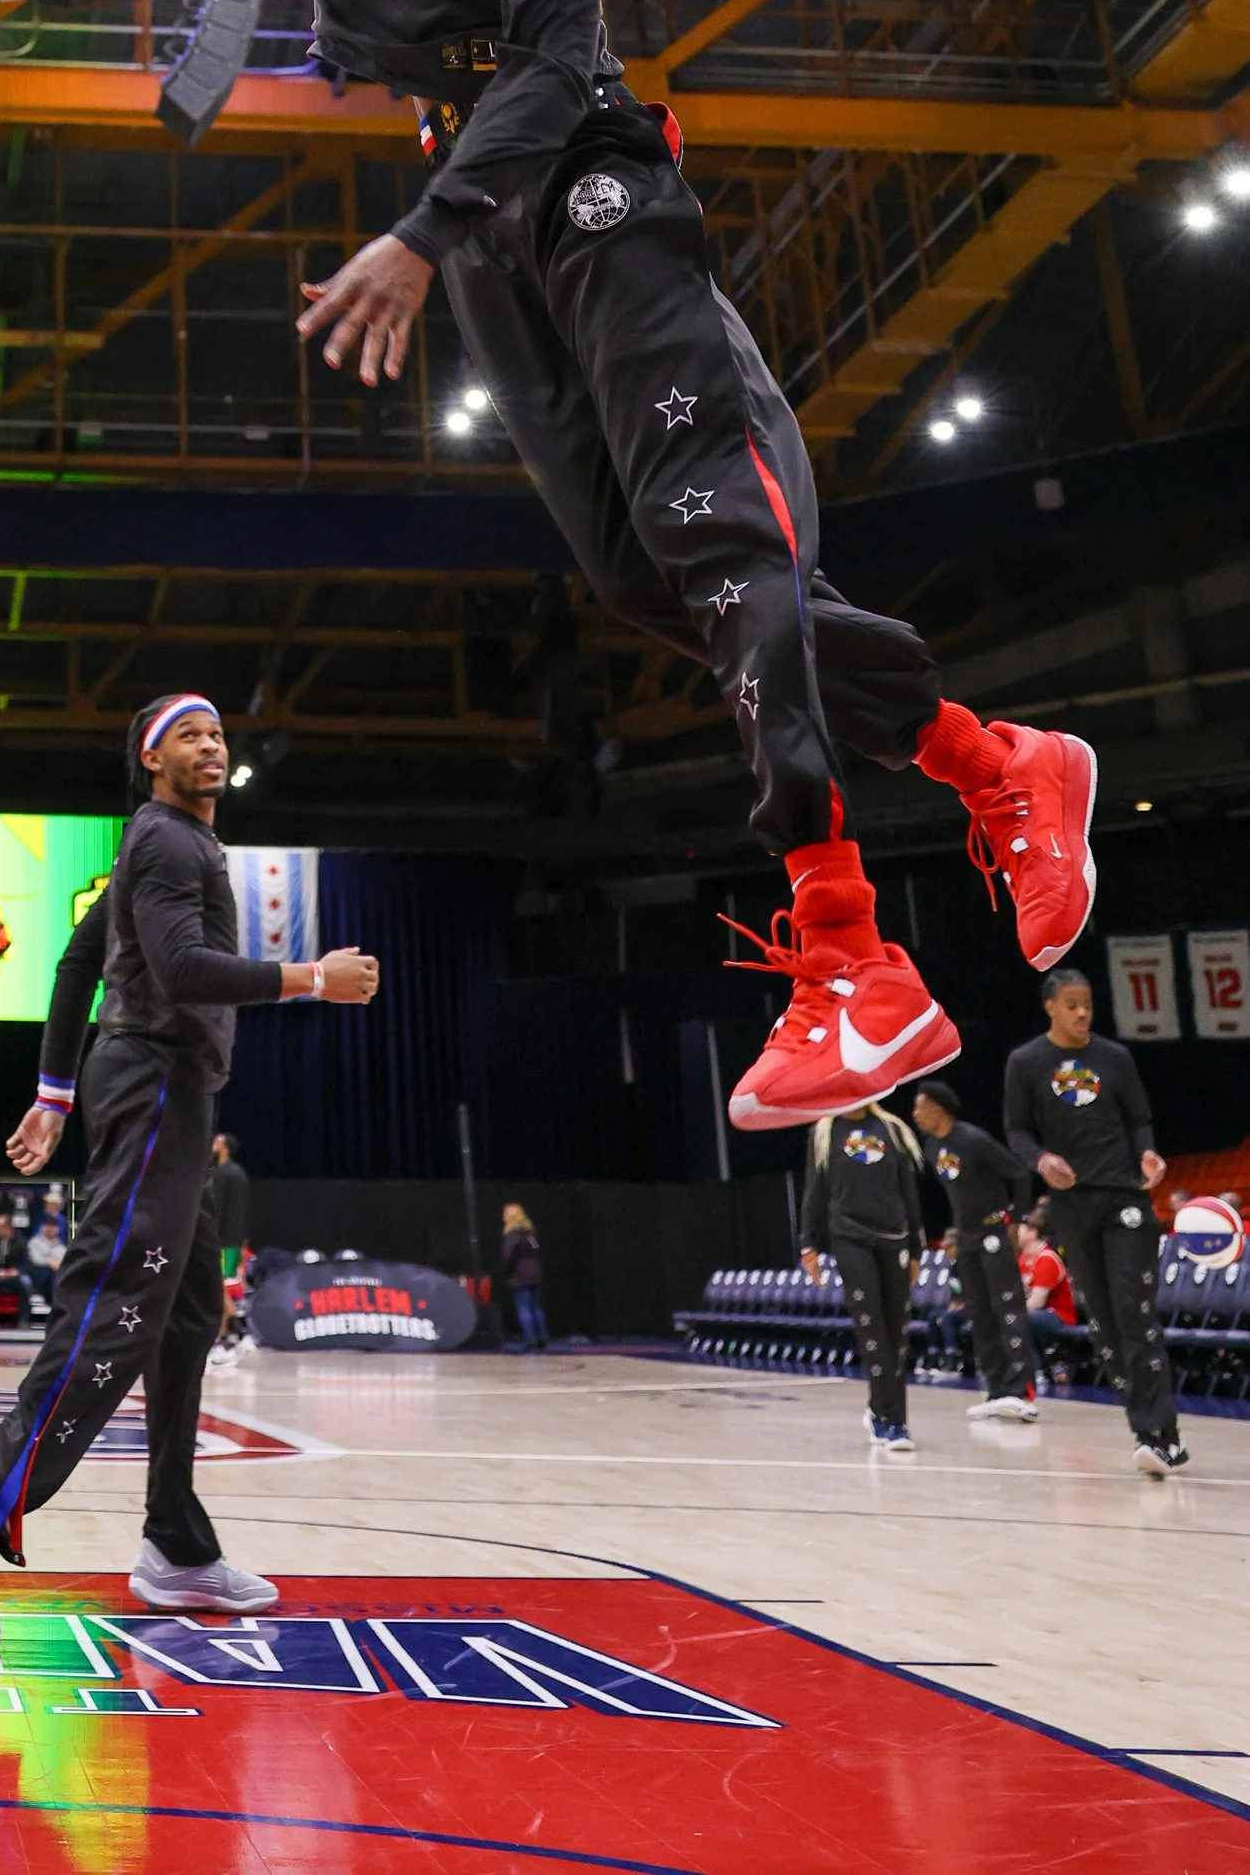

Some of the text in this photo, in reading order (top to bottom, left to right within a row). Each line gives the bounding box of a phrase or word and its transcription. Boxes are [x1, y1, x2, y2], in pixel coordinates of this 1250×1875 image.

[1128, 972, 1159, 1013] 11
[1204, 967, 1244, 1010] 12
[309, 1285, 412, 1317] HARLEM
